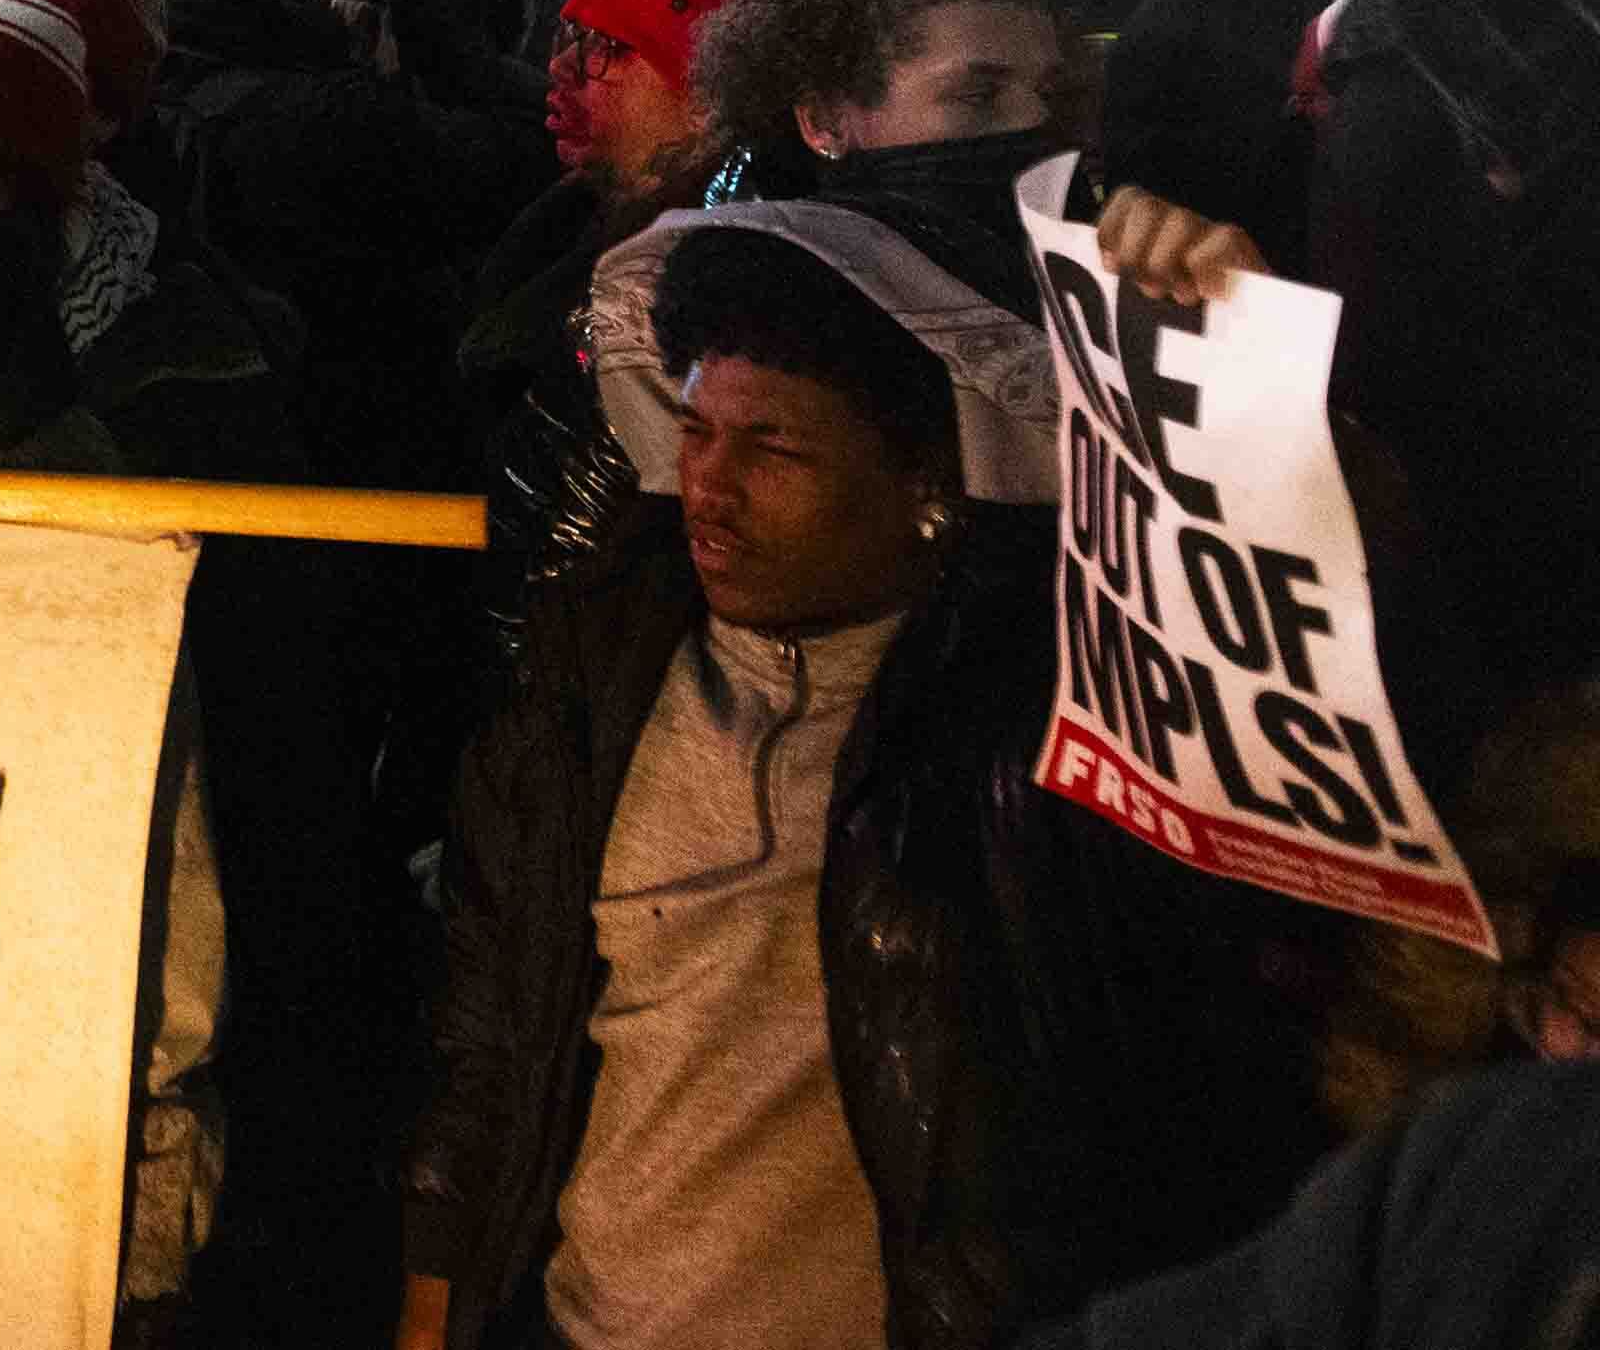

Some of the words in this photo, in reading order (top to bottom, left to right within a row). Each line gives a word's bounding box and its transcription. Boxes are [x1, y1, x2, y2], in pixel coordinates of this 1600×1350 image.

[1070, 406, 1166, 634] OUT
[1176, 525, 1334, 698] OF
[1054, 736, 1198, 855] FRSO
[1065, 543, 1442, 868] MPLS!
